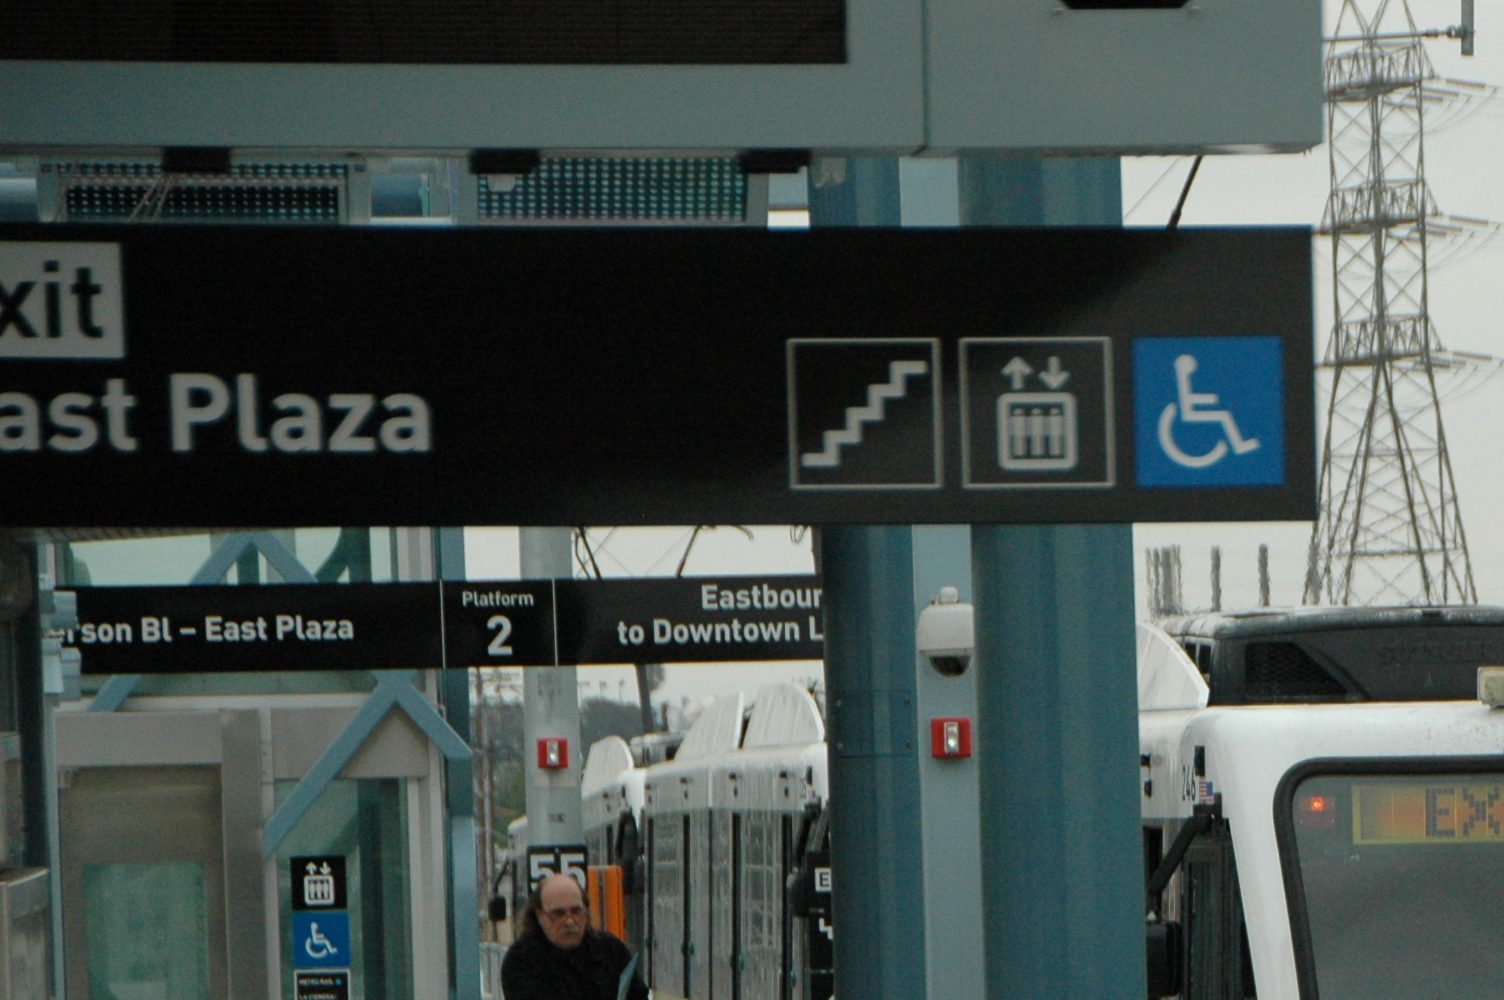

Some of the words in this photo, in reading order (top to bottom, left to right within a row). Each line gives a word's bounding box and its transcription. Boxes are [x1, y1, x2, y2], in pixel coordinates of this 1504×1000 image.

[0, 260, 104, 339] xit
[0, 377, 138, 452] ast
[169, 373, 431, 452] Plaza
[462, 590, 534, 607] Platform
[141, 617, 172, 643] Bl
[205, 615, 268, 641] East
[276, 615, 354, 640] Plaza
[487, 615, 513, 656] 2
[617, 622, 645, 646] to
[653, 616, 800, 644] Downtown
